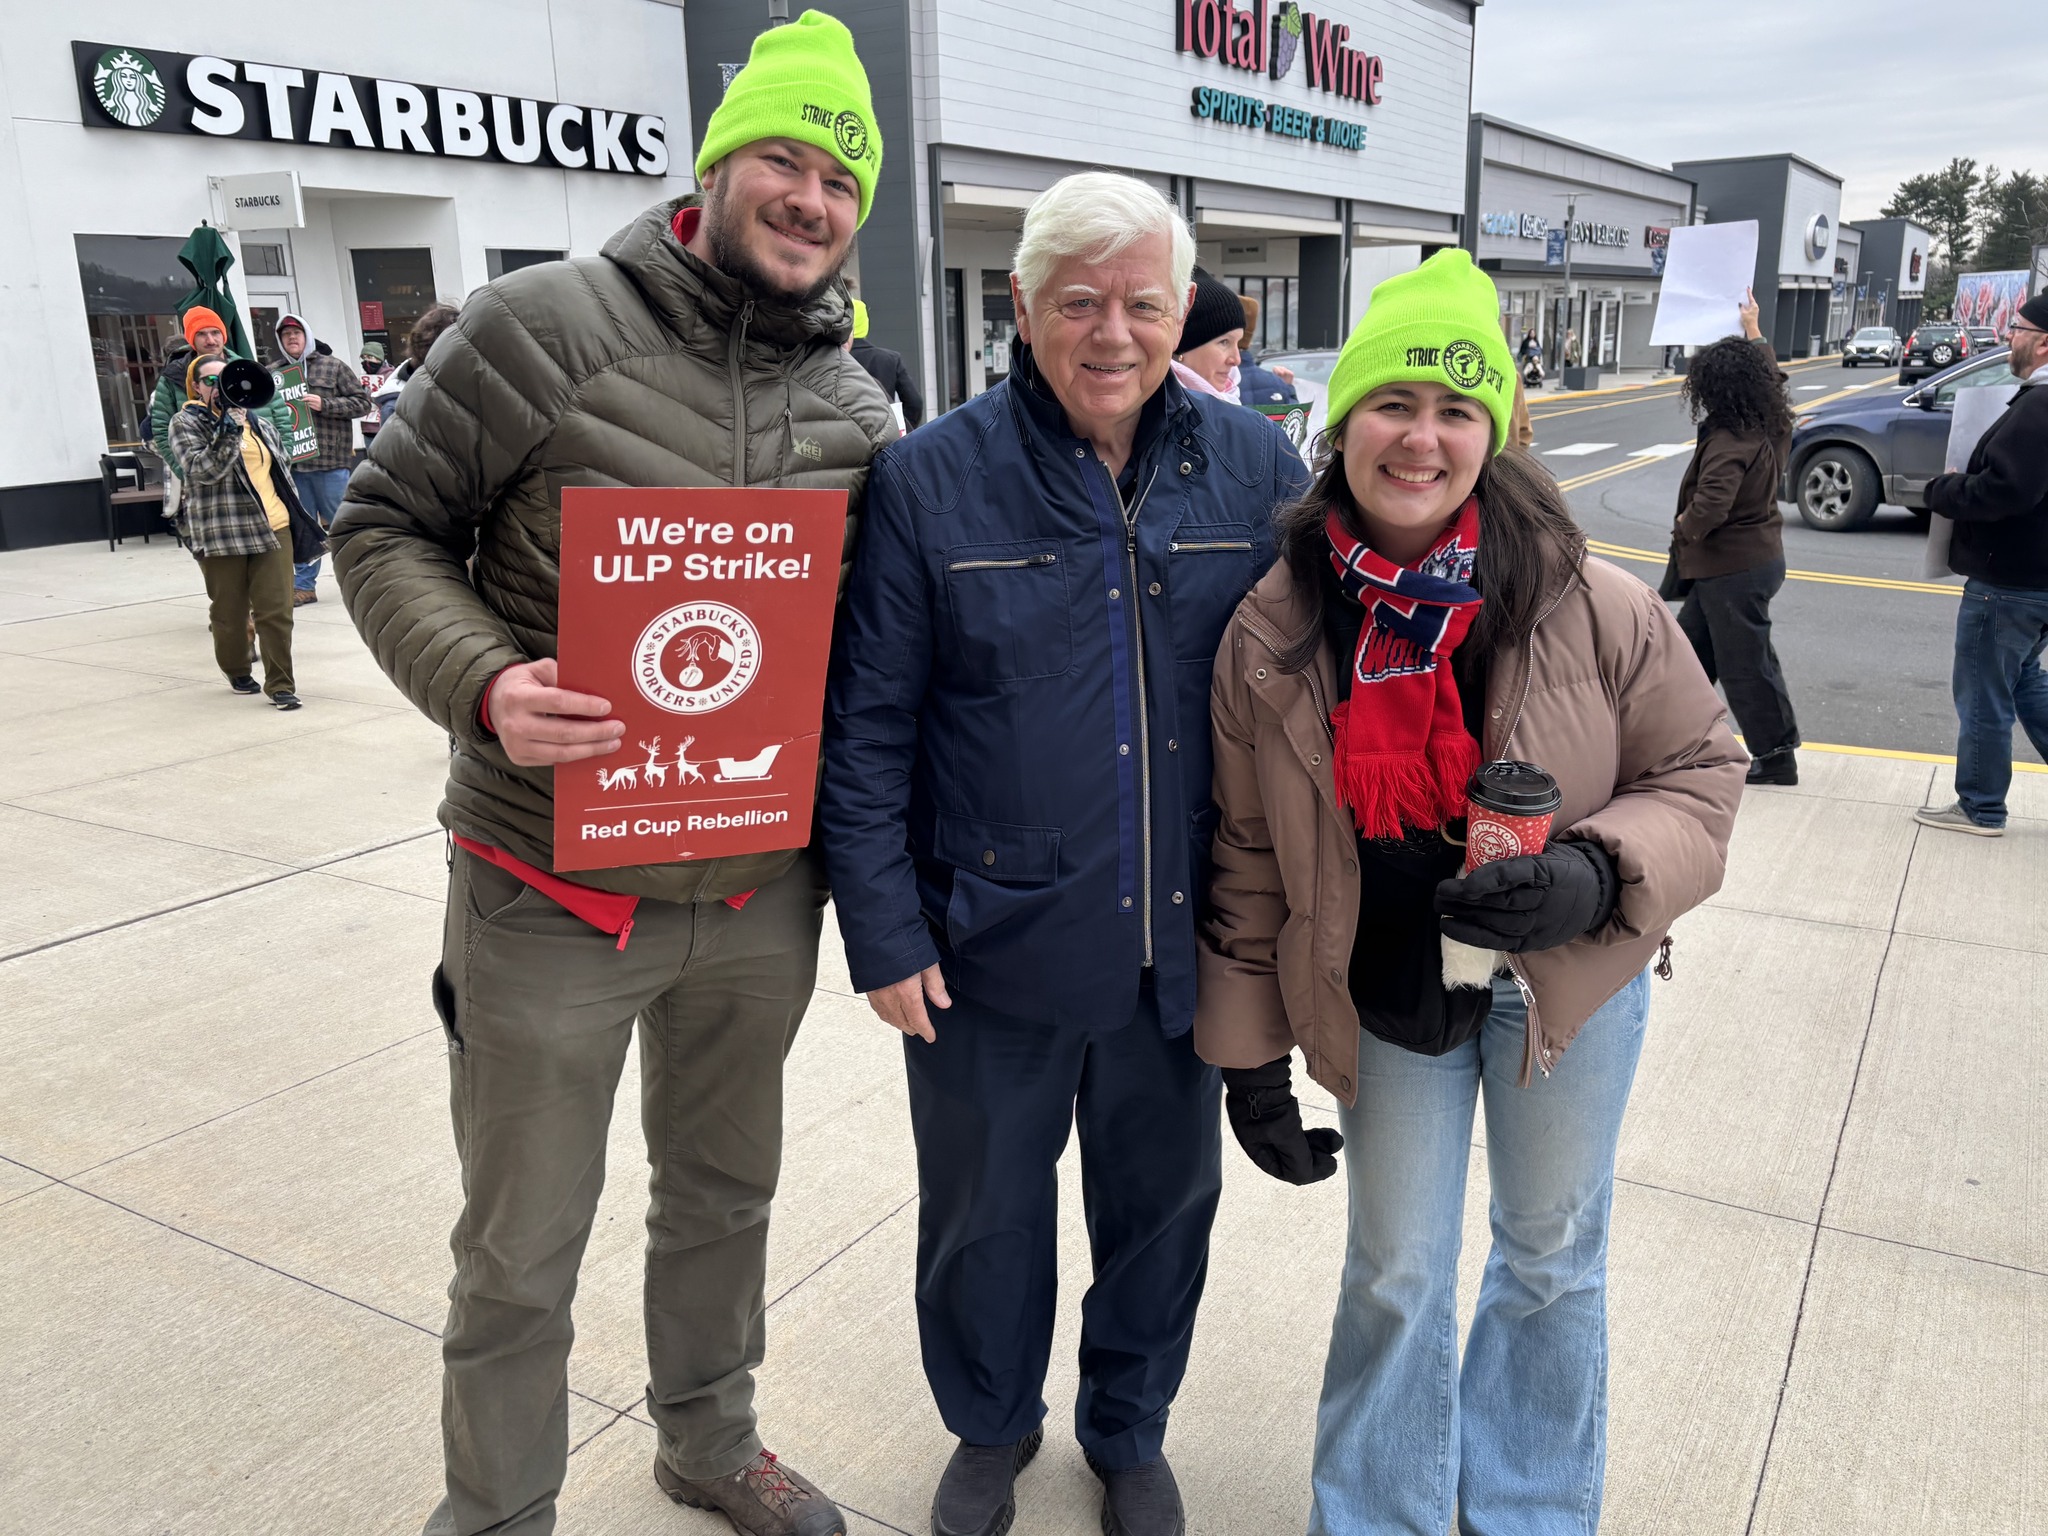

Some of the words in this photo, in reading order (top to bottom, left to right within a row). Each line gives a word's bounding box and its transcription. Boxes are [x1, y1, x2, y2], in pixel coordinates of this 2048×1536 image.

[1303, 12, 1384, 105] Wine
[186, 55, 670, 177] STARBUCKS
[801, 103, 835, 129] STRIKE
[1196, 86, 1265, 128] SPIRITS
[1271, 104, 1312, 140] BEER
[1315, 114, 1326, 142] &
[1328, 117, 1368, 150] MORE
[234, 195, 281, 208] STARBUCKS
[1406, 347, 1440, 367] STRIKE
[1450, 342, 1482, 362] STARBUCKS
[1445, 357, 1464, 384] WORKERS
[279, 382, 308, 402] TRIKE
[292, 438, 318, 456] BUCKS!
[293, 425, 316, 442] RACT,
[803, 444, 822, 458] REI
[617, 516, 734, 546] We're
[745, 521, 794, 544] on
[593, 554, 672, 583] ULP
[683, 552, 811, 581] Strike!
[652, 609, 748, 642] STARBUCKS
[642, 652, 696, 707] WORKERS
[709, 649, 752, 703] UNITED
[581, 818, 627, 841] Red
[633, 817, 680, 838] Cup
[686, 808, 788, 832] Rebellion
[1471, 823, 1518, 851] PERKATORY
